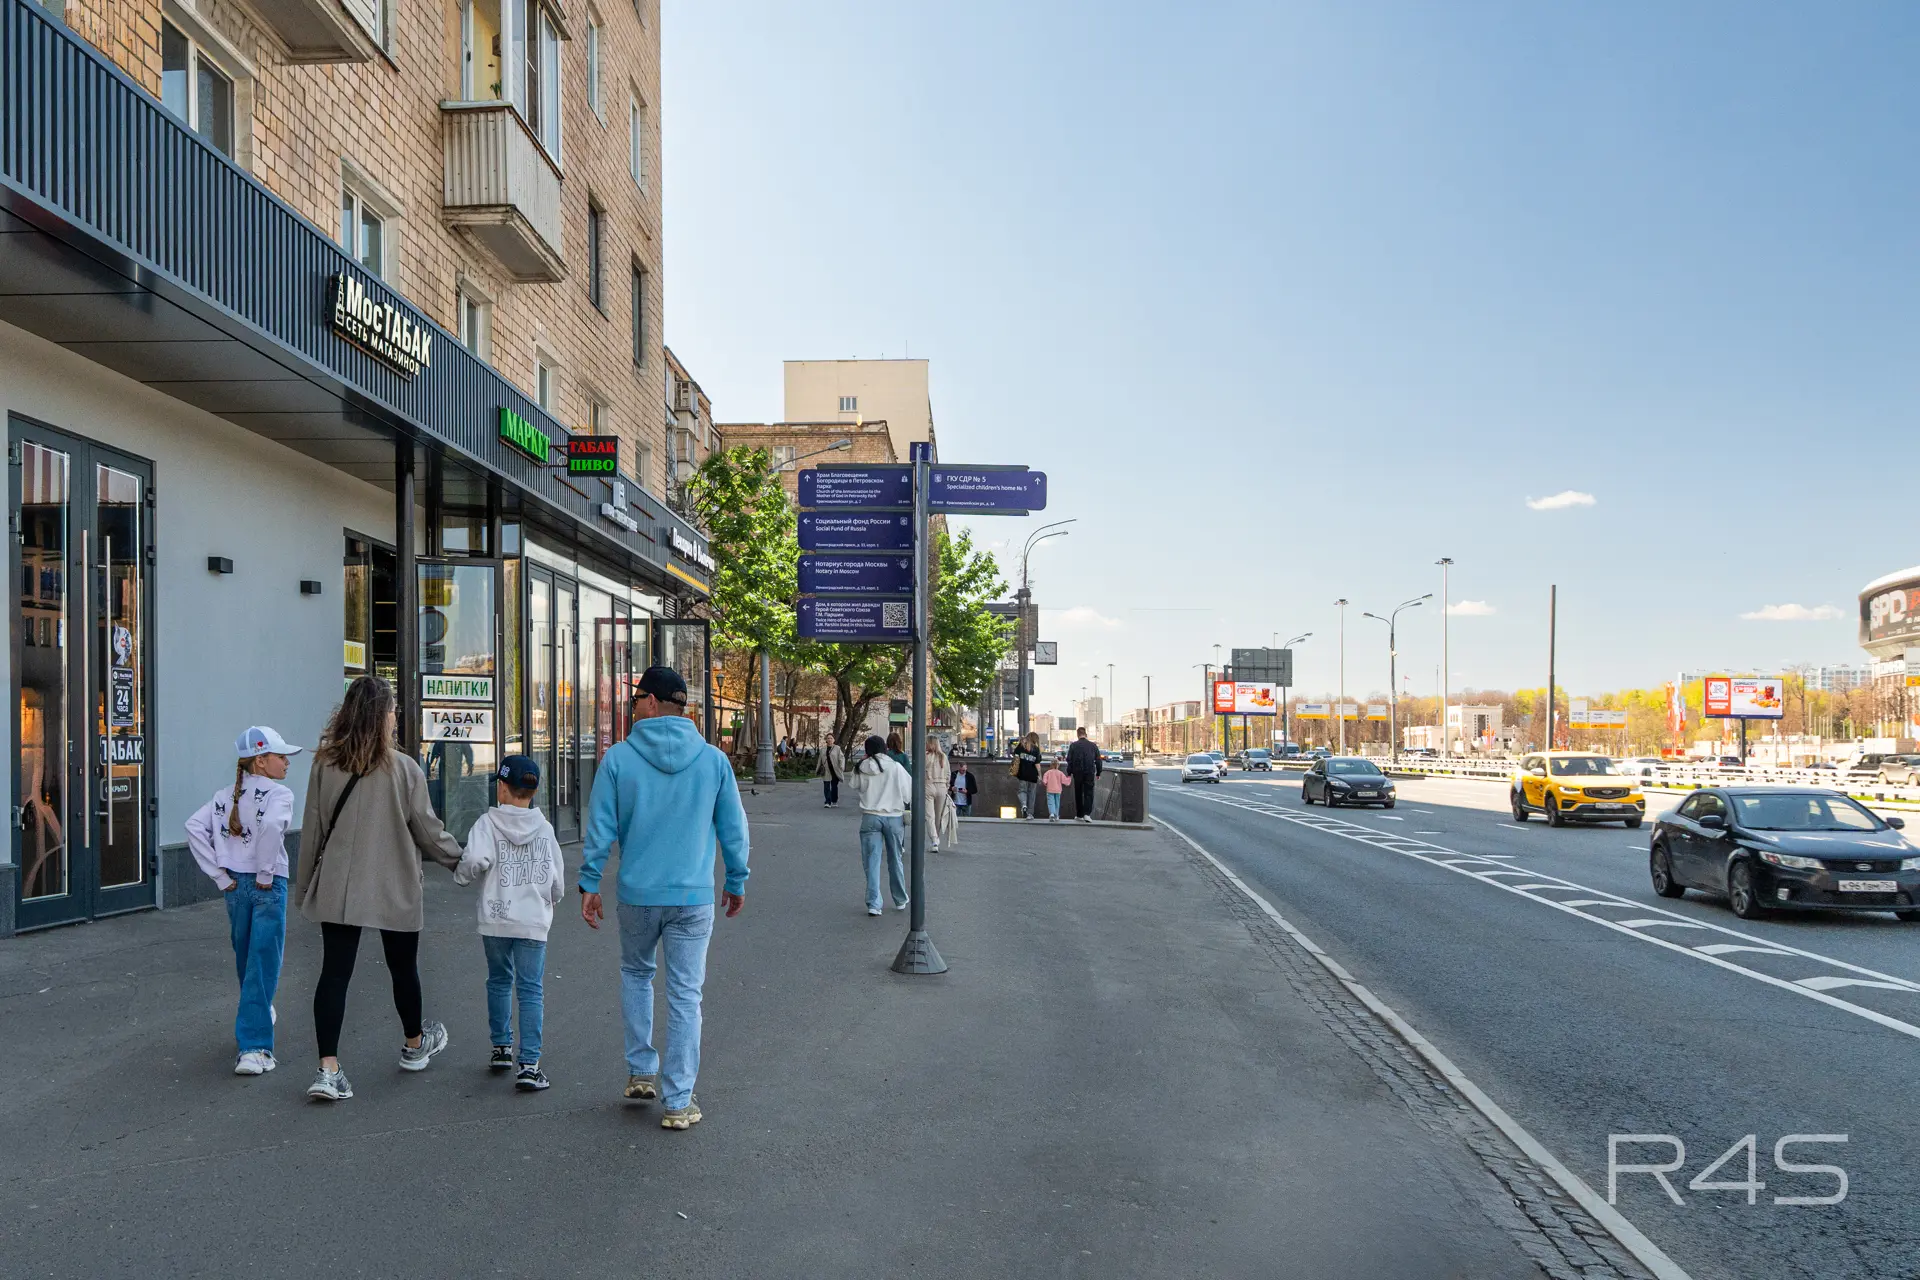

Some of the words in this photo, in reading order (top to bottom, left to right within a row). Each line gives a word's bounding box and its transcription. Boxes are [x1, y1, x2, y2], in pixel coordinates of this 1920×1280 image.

[346, 275, 432, 368] МосТАБАК
[346, 316, 368, 342] СЕТЬ
[371, 332, 420, 376] МАГАЗИНОВ
[503, 408, 550, 462] МАРКЕТ
[568, 442, 616, 453] ТАБАК
[570, 460, 614, 470] ПИВО
[427, 680, 488, 696] НАПИТКИ
[117, 690, 129, 706] 24
[431, 712, 484, 724] ТАБАК
[443, 726, 472, 738] 24/7
[102, 739, 142, 760] ТАБАК
[497, 836, 552, 864] BRAWL
[500, 861, 550, 887] STARS
